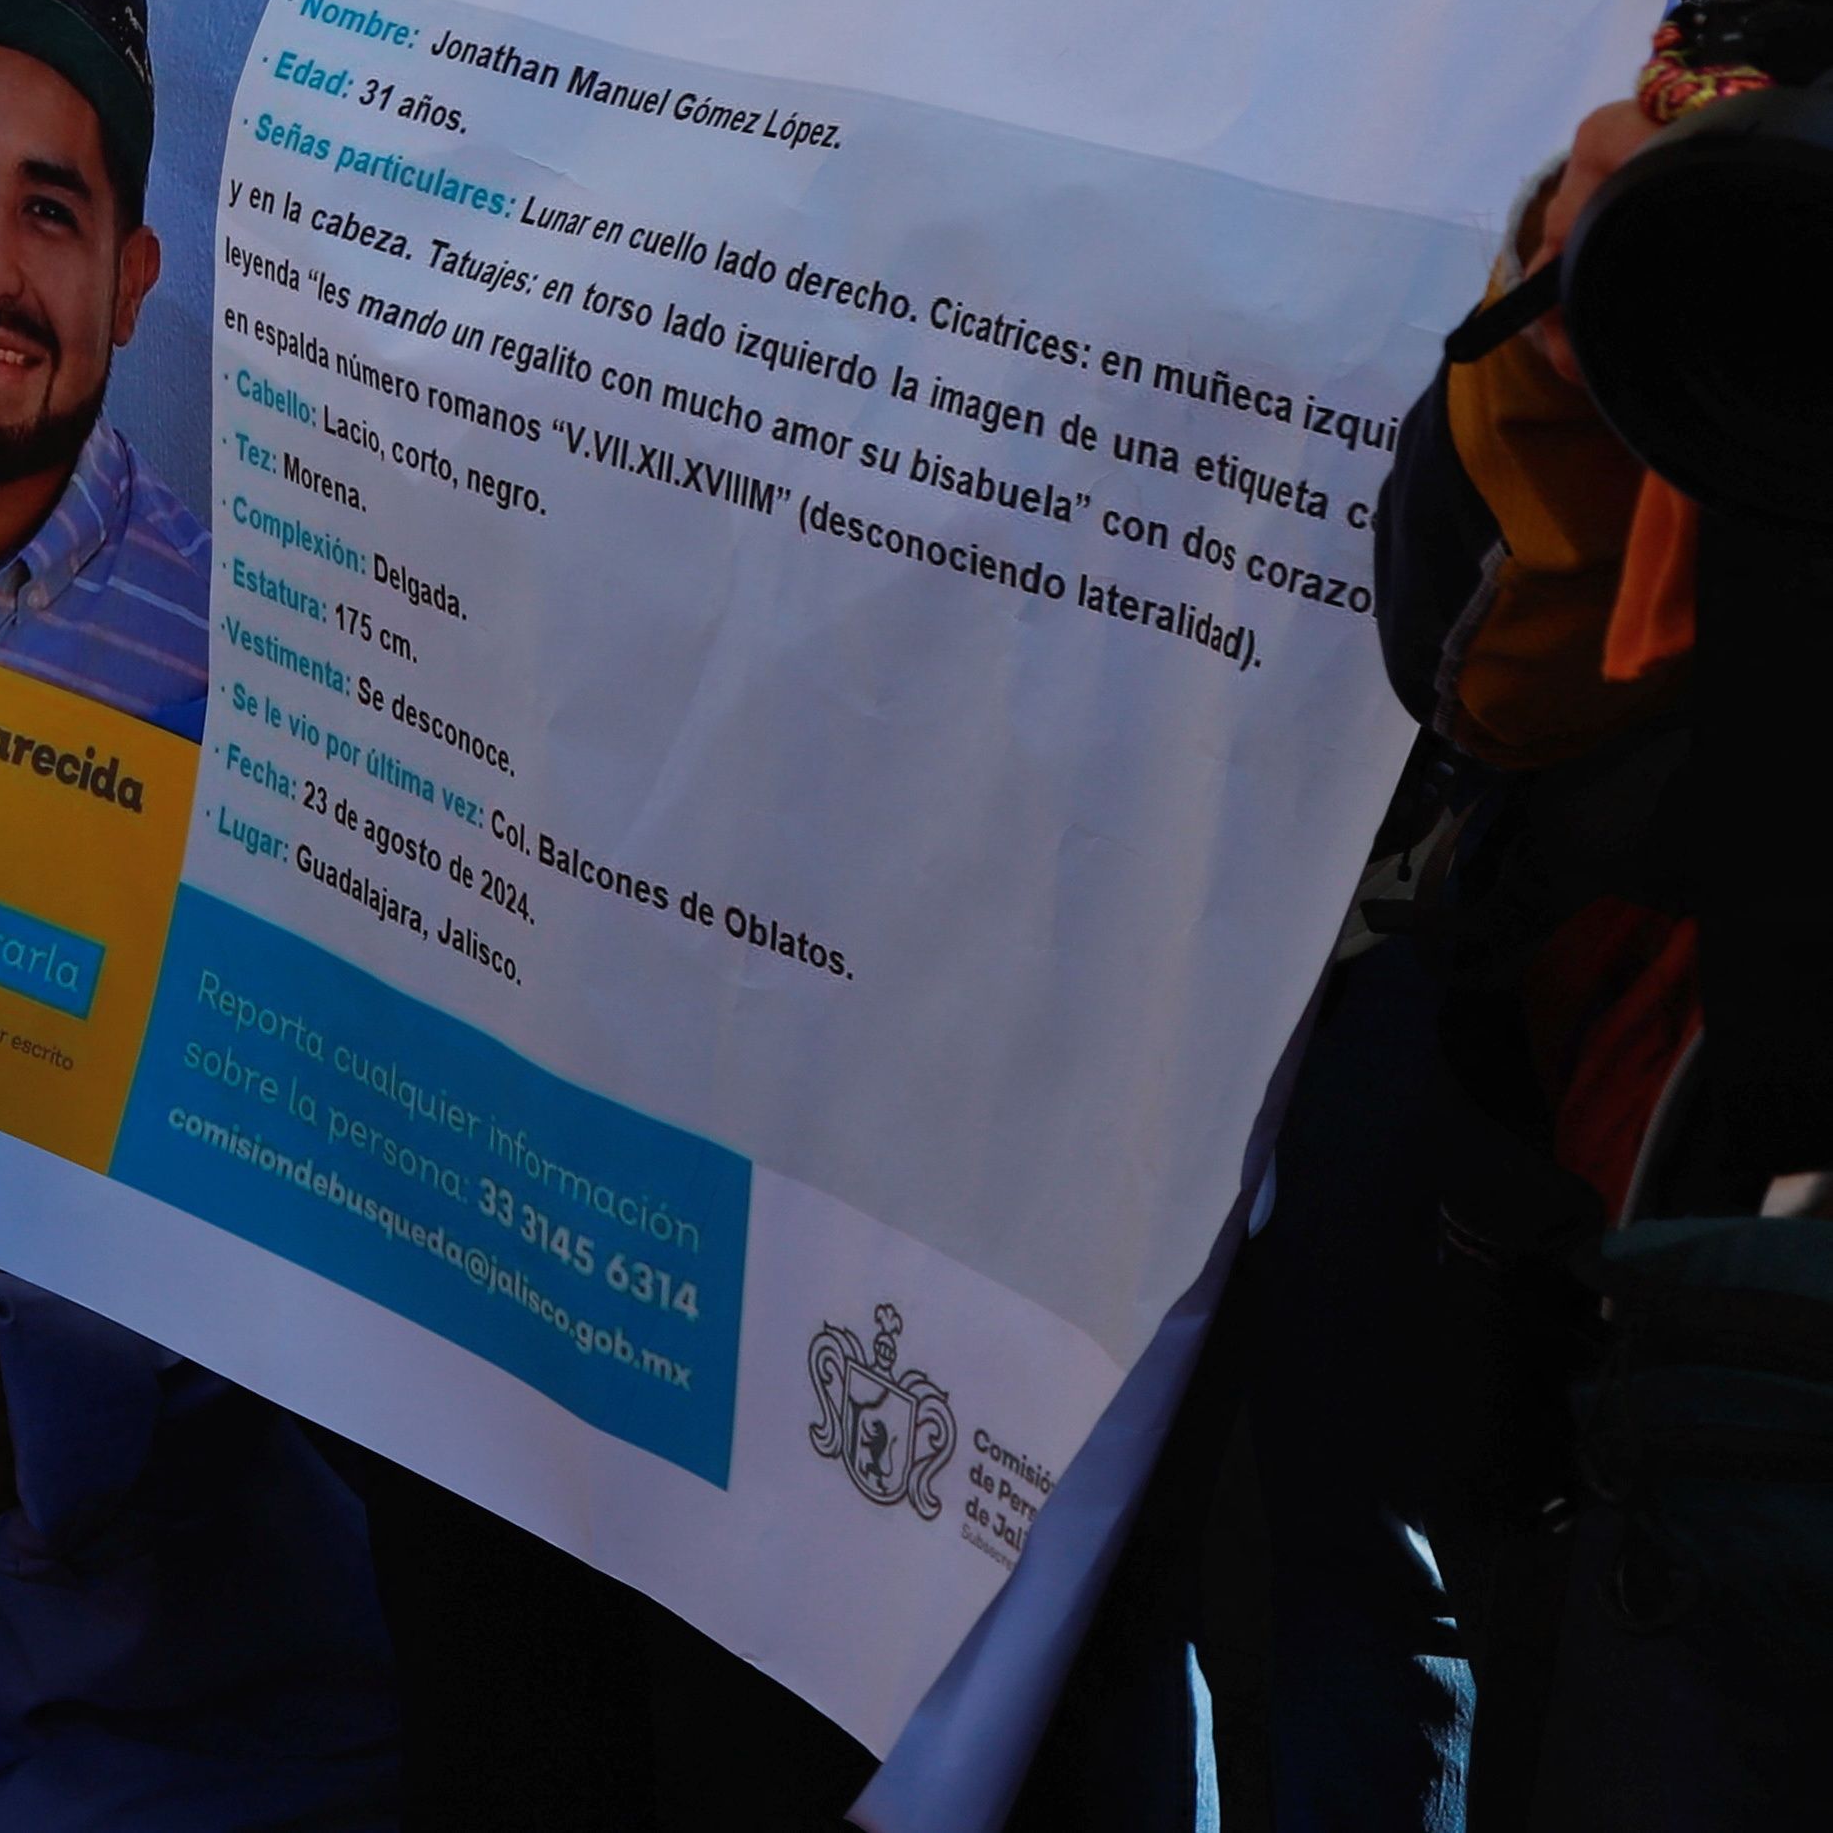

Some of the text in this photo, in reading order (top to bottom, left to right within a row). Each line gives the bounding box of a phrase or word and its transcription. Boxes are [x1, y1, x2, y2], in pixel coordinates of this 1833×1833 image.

[274, 51, 466, 134] Edad: 31 años.
[431, 30, 559, 88] Jonathan
[567, 66, 672, 115] Manuel
[674, 93, 762, 134] Gómez
[762, 109, 840, 150] López.
[255, 113, 331, 160] Señas
[334, 146, 516, 218] particulares:
[520, 196, 592, 235] Lunar
[592, 220, 624, 244] en
[629, 228, 707, 265] cuello
[714, 241, 776, 283] lado
[786, 262, 916, 322] derecho.
[931, 297, 1091, 369] Cicatrices:
[1101, 351, 1142, 383] en
[1154, 364, 1292, 423] muñeca
[226, 237, 299, 291] leyenda
[357, 294, 447, 339] mando
[452, 324, 484, 351] un
[490, 334, 591, 382] regalito
[602, 368, 652, 402] con
[662, 384, 762, 433] mucho
[772, 418, 853, 459] amor
[859, 443, 900, 474] su
[1103, 511, 1168, 549] con
[1183, 525, 1236, 570] dos
[1247, 555, 1376, 617] corazo
[229, 180, 242, 207] y
[250, 187, 274, 214] en
[283, 191, 302, 224] la
[311, 209, 411, 260] cabeza.
[430, 239, 538, 294] Tatuajes:
[543, 279, 574, 305] en
[583, 283, 652, 326] torso
[663, 303, 725, 347] lado
[736, 331, 876, 389] izquierdo
[891, 366, 918, 402] la
[930, 384, 1044, 437] imagen
[1061, 414, 1097, 451] de
[1114, 434, 1178, 473] una
[1195, 454, 1328, 519] etiqueta
[225, 309, 247, 335] en
[255, 320, 329, 369] espalda
[337, 354, 419, 402] número
[428, 387, 541, 442] romanos
[800, 495, 1065, 599] (desconociendo
[1078, 574, 1261, 671] lateralidad).
[236, 432, 366, 512] Tez: Morena.
[237, 369, 546, 515] Cabello: Lacio, corto, negro.
[233, 496, 466, 620] Complexión: Delgada.
[234, 558, 417, 663] Estatura: 175 cm.
[226, 616, 514, 777] Vestimenta: Se desconoce.
[218, 805, 521, 986] Lugar: Guadalajara, Jalisco.
[227, 743, 534, 925] Fecha: 23 de agosto de 2024.
[233, 682, 853, 980] Se le vio por última vez: Col. Balcones de Oblatos.
[11, 1035, 74, 1071] escrito
[197, 969, 699, 1254] Reporta cualquier información
[168, 1107, 692, 1391] comisiondebusqueda@jalisco.gob.mx
[184, 1042, 699, 1322] sobre la persona: 33 3145 6314
[965, 1496, 1028, 1553] de Jal
[969, 1464, 995, 1494] de
[973, 1428, 1055, 1494] Comisió
